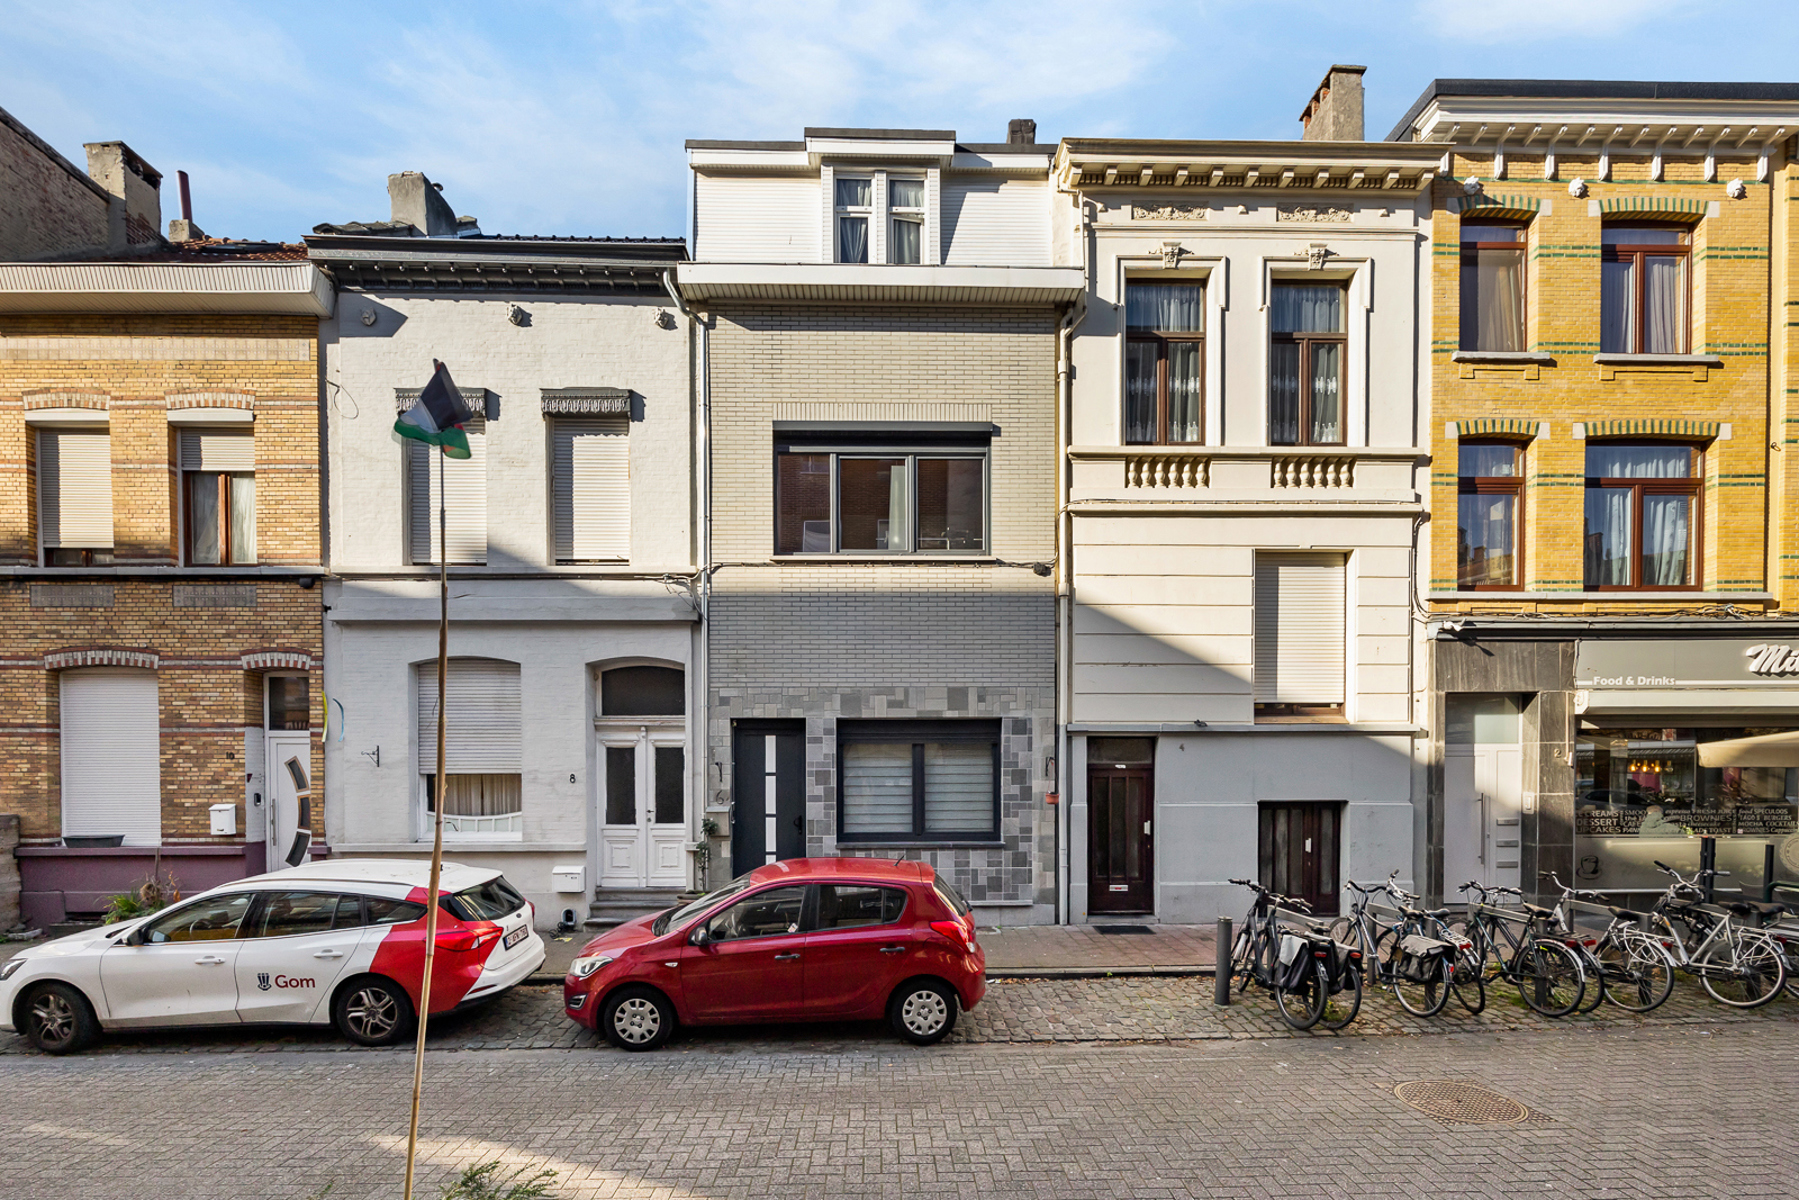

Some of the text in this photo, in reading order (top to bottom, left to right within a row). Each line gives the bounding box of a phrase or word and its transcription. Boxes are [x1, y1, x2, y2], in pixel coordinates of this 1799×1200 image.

[1593, 676, 1675, 685] Food & Drinks
[225, 751, 235, 760] 10
[1554, 748, 1562, 758] 2
[569, 773, 577, 784] 8
[715, 789, 725, 805] 6
[1576, 818, 1618, 826] DESSERT
[1680, 814, 1733, 822] BROWNIES
[1576, 826, 1621, 834] UPCAKES
[274, 974, 316, 989] Gom
